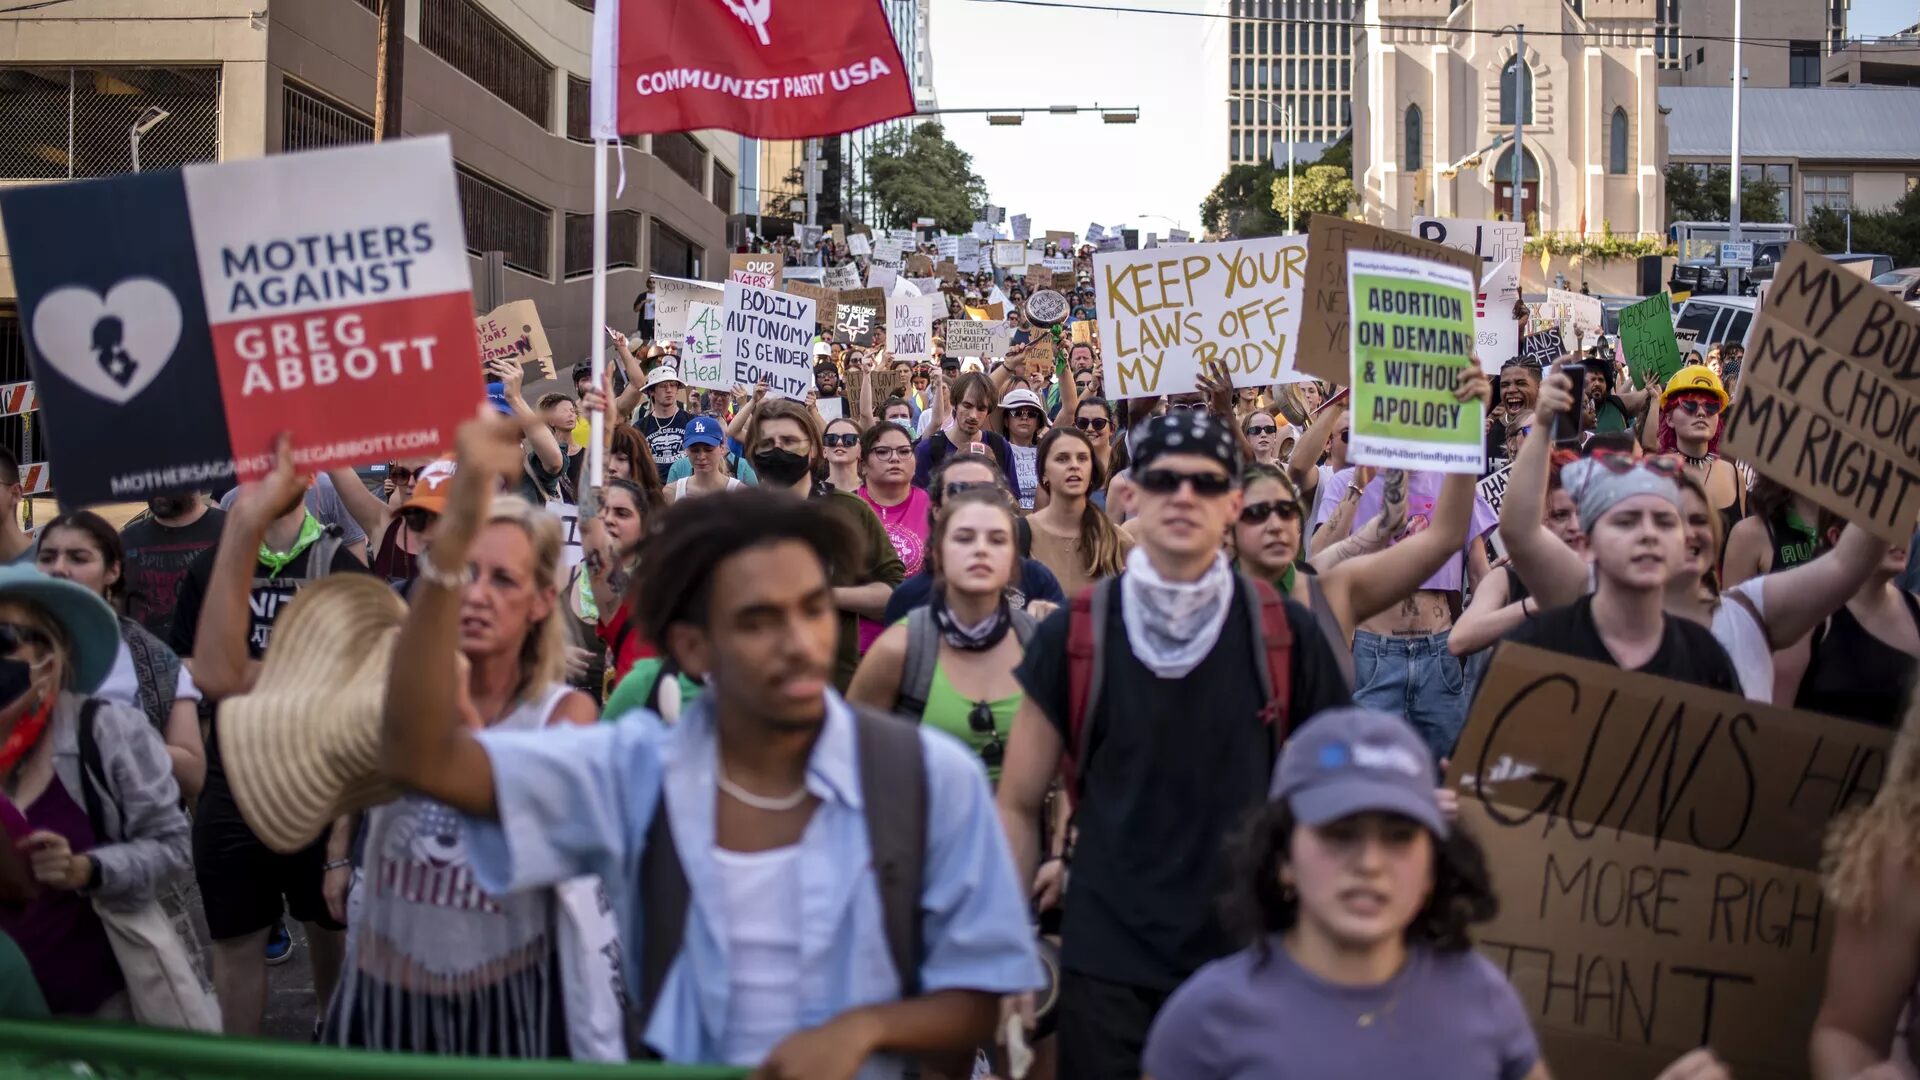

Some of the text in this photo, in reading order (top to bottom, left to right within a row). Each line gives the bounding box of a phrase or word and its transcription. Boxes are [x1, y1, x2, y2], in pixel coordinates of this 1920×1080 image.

[636, 56, 890, 100] COMMUNIST PARTY USA
[221, 222, 435, 278] MOTHERS
[746, 261, 775, 274] OUR
[229, 259, 415, 313] AGAINST
[1106, 245, 1307, 320] KEEP YOUR
[741, 289, 808, 320] BODILY
[837, 304, 877, 316] THIS BELONGS
[837, 312, 870, 328] TO ME
[895, 305, 910, 319] NO
[1368, 287, 1463, 322] ABORTION
[1620, 295, 1669, 329] ABORTION
[1775, 260, 1920, 382] MY BOD
[234, 314, 365, 361] GREG
[726, 311, 814, 347] AUTONOMY
[894, 317, 925, 329] LONGER
[1116, 296, 1289, 357] LAWS OFF
[1359, 321, 1473, 357] ON DEMAND
[1636, 326, 1652, 343] IS
[1675, 331, 1698, 342] ANCY
[736, 338, 810, 369] IS GENDER
[894, 332, 926, 354] DEMOCRACY
[1523, 329, 1561, 355] ANDS
[241, 338, 438, 396] ABBOTT
[684, 358, 721, 382] Heal
[735, 361, 807, 396] EQUALITY
[1116, 334, 1287, 395] MY BODY
[1363, 359, 1463, 394] & WITHOU
[1750, 327, 1920, 463] MY CHOIC
[694, 421, 706, 433] LA
[1372, 396, 1462, 430] APOLOGY
[646, 428, 686, 442] PHILADELPHI
[111, 429, 440, 495] MOTHERSAGAINSTREGABBOTT.COM
[1726, 385, 1920, 528] MY RIGHT
[1476, 673, 1887, 852] GUNS HA
[1540, 853, 1823, 954] MORE RIGH
[1480, 940, 1660, 1044] THAN
